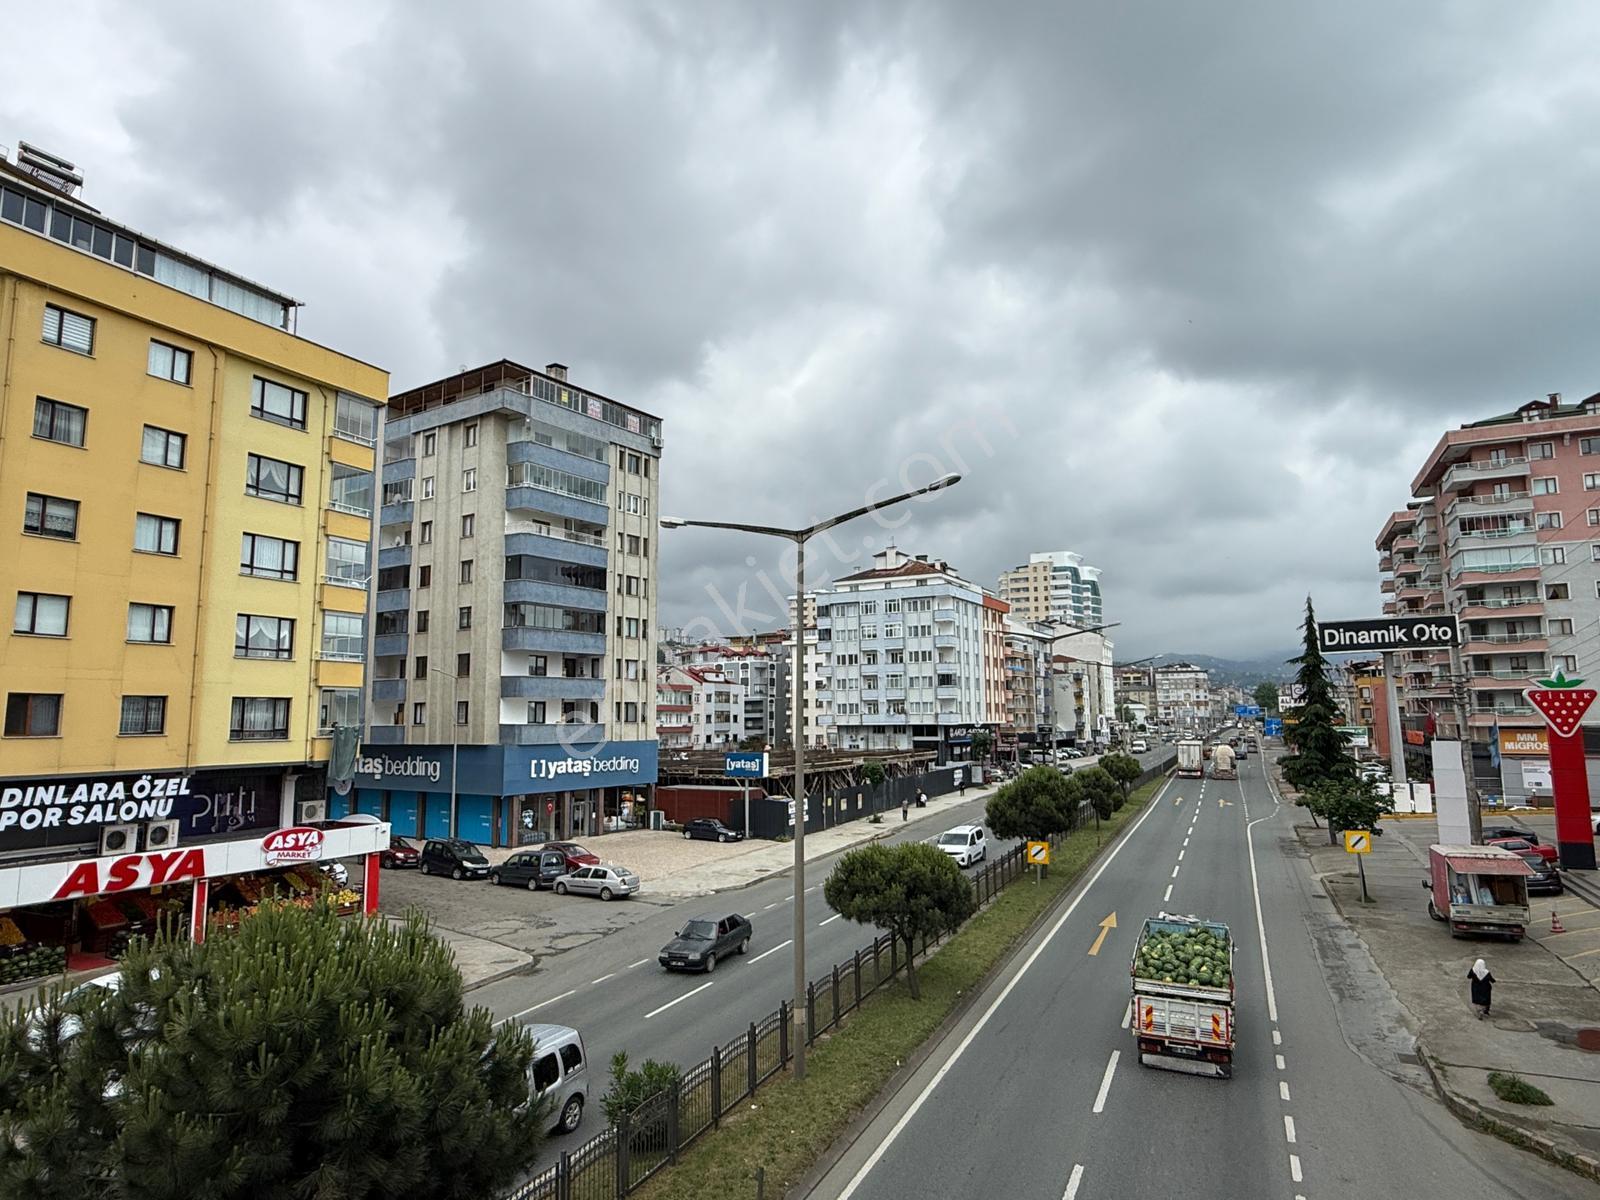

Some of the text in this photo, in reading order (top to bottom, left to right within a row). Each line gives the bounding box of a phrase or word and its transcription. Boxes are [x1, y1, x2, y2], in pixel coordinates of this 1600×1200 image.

[1323, 623, 1452, 646] Dinamik Oto
[1534, 692, 1592, 702] ÇİLEK
[1516, 733, 1537, 741] MM
[384, 755, 441, 781] bedding
[547, 757, 592, 779] yataş
[593, 756, 640, 774] bedding
[132, 775, 190, 799] ÖZEL
[0, 798, 174, 831] POR SALONU
[268, 830, 319, 850] ASYA
[52, 848, 206, 899] ASYA
